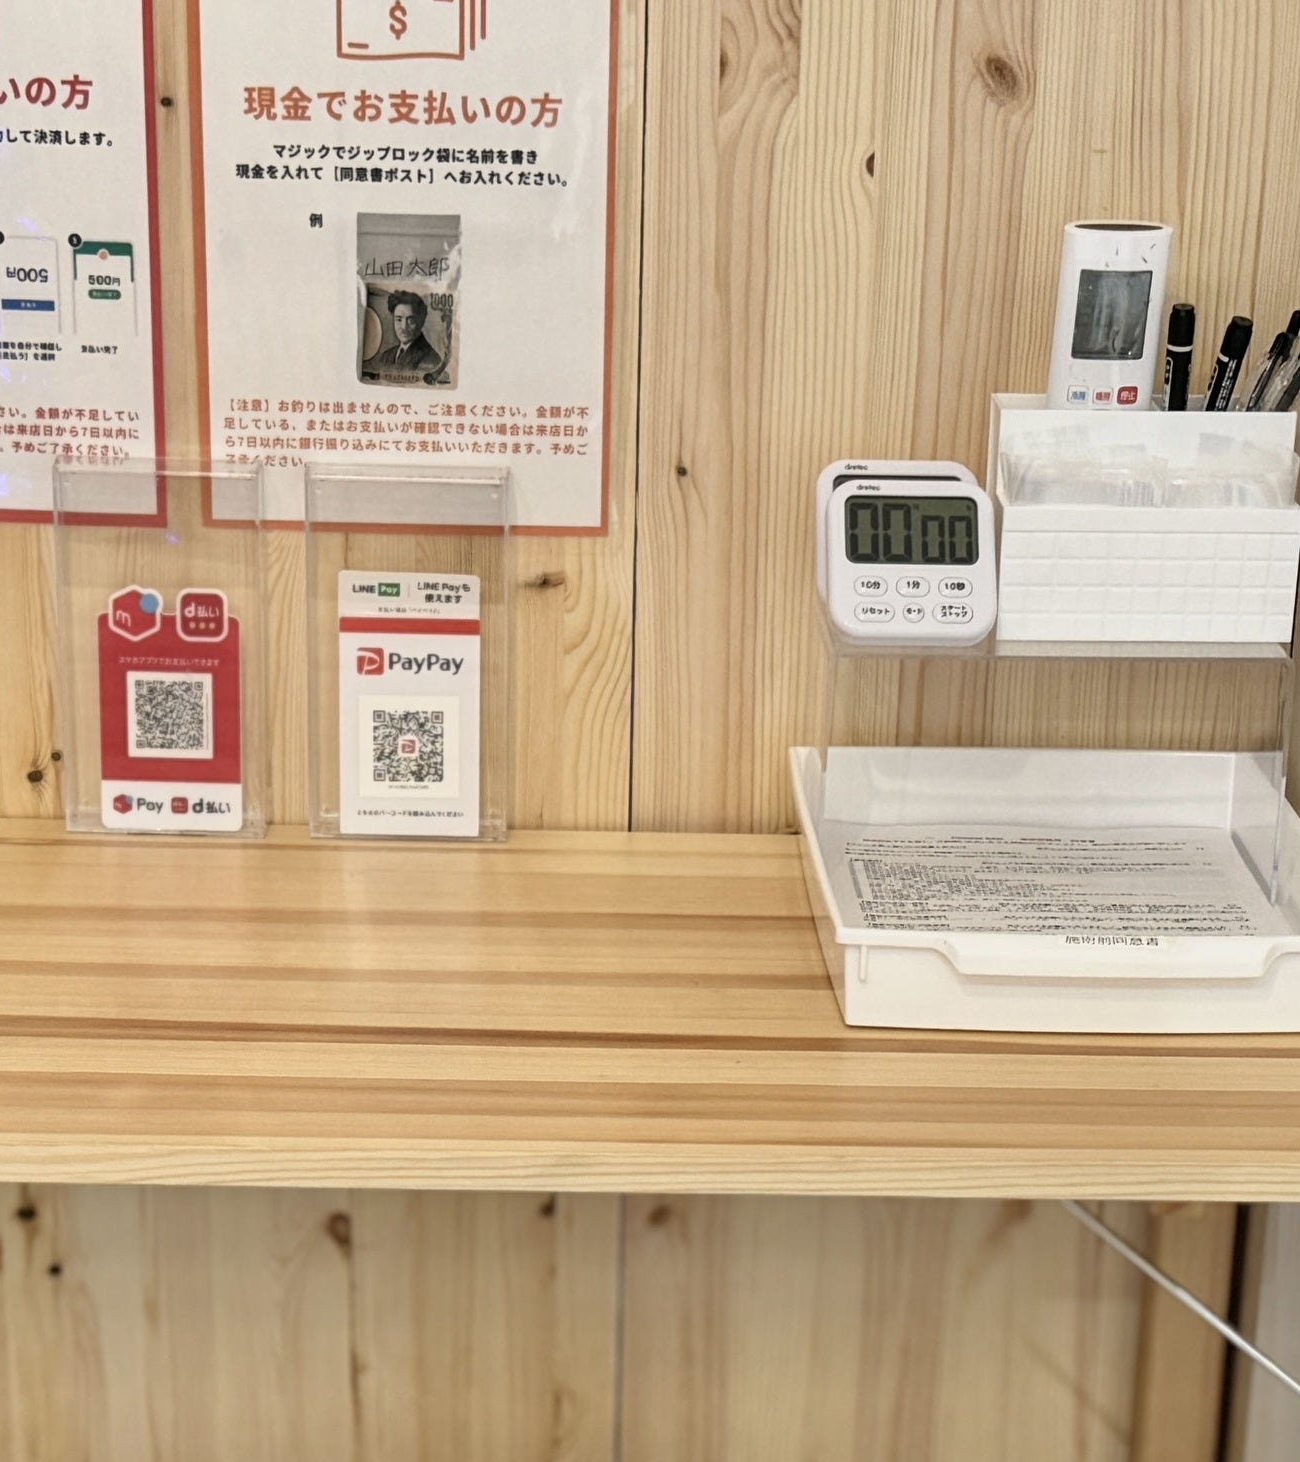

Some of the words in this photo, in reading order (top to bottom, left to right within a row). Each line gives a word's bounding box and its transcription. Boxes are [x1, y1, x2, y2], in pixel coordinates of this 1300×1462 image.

[243, 86, 563, 129] 現金でお支払いの方
[273, 143, 539, 166] マジックでジップロック袋に名前を書き
[309, 212, 324, 229] 例
[88, 274, 121, 288] 500円
[352, 583, 377, 595] LINE
[388, 653, 464, 676] PayPay
[136, 798, 164, 815] Pay
